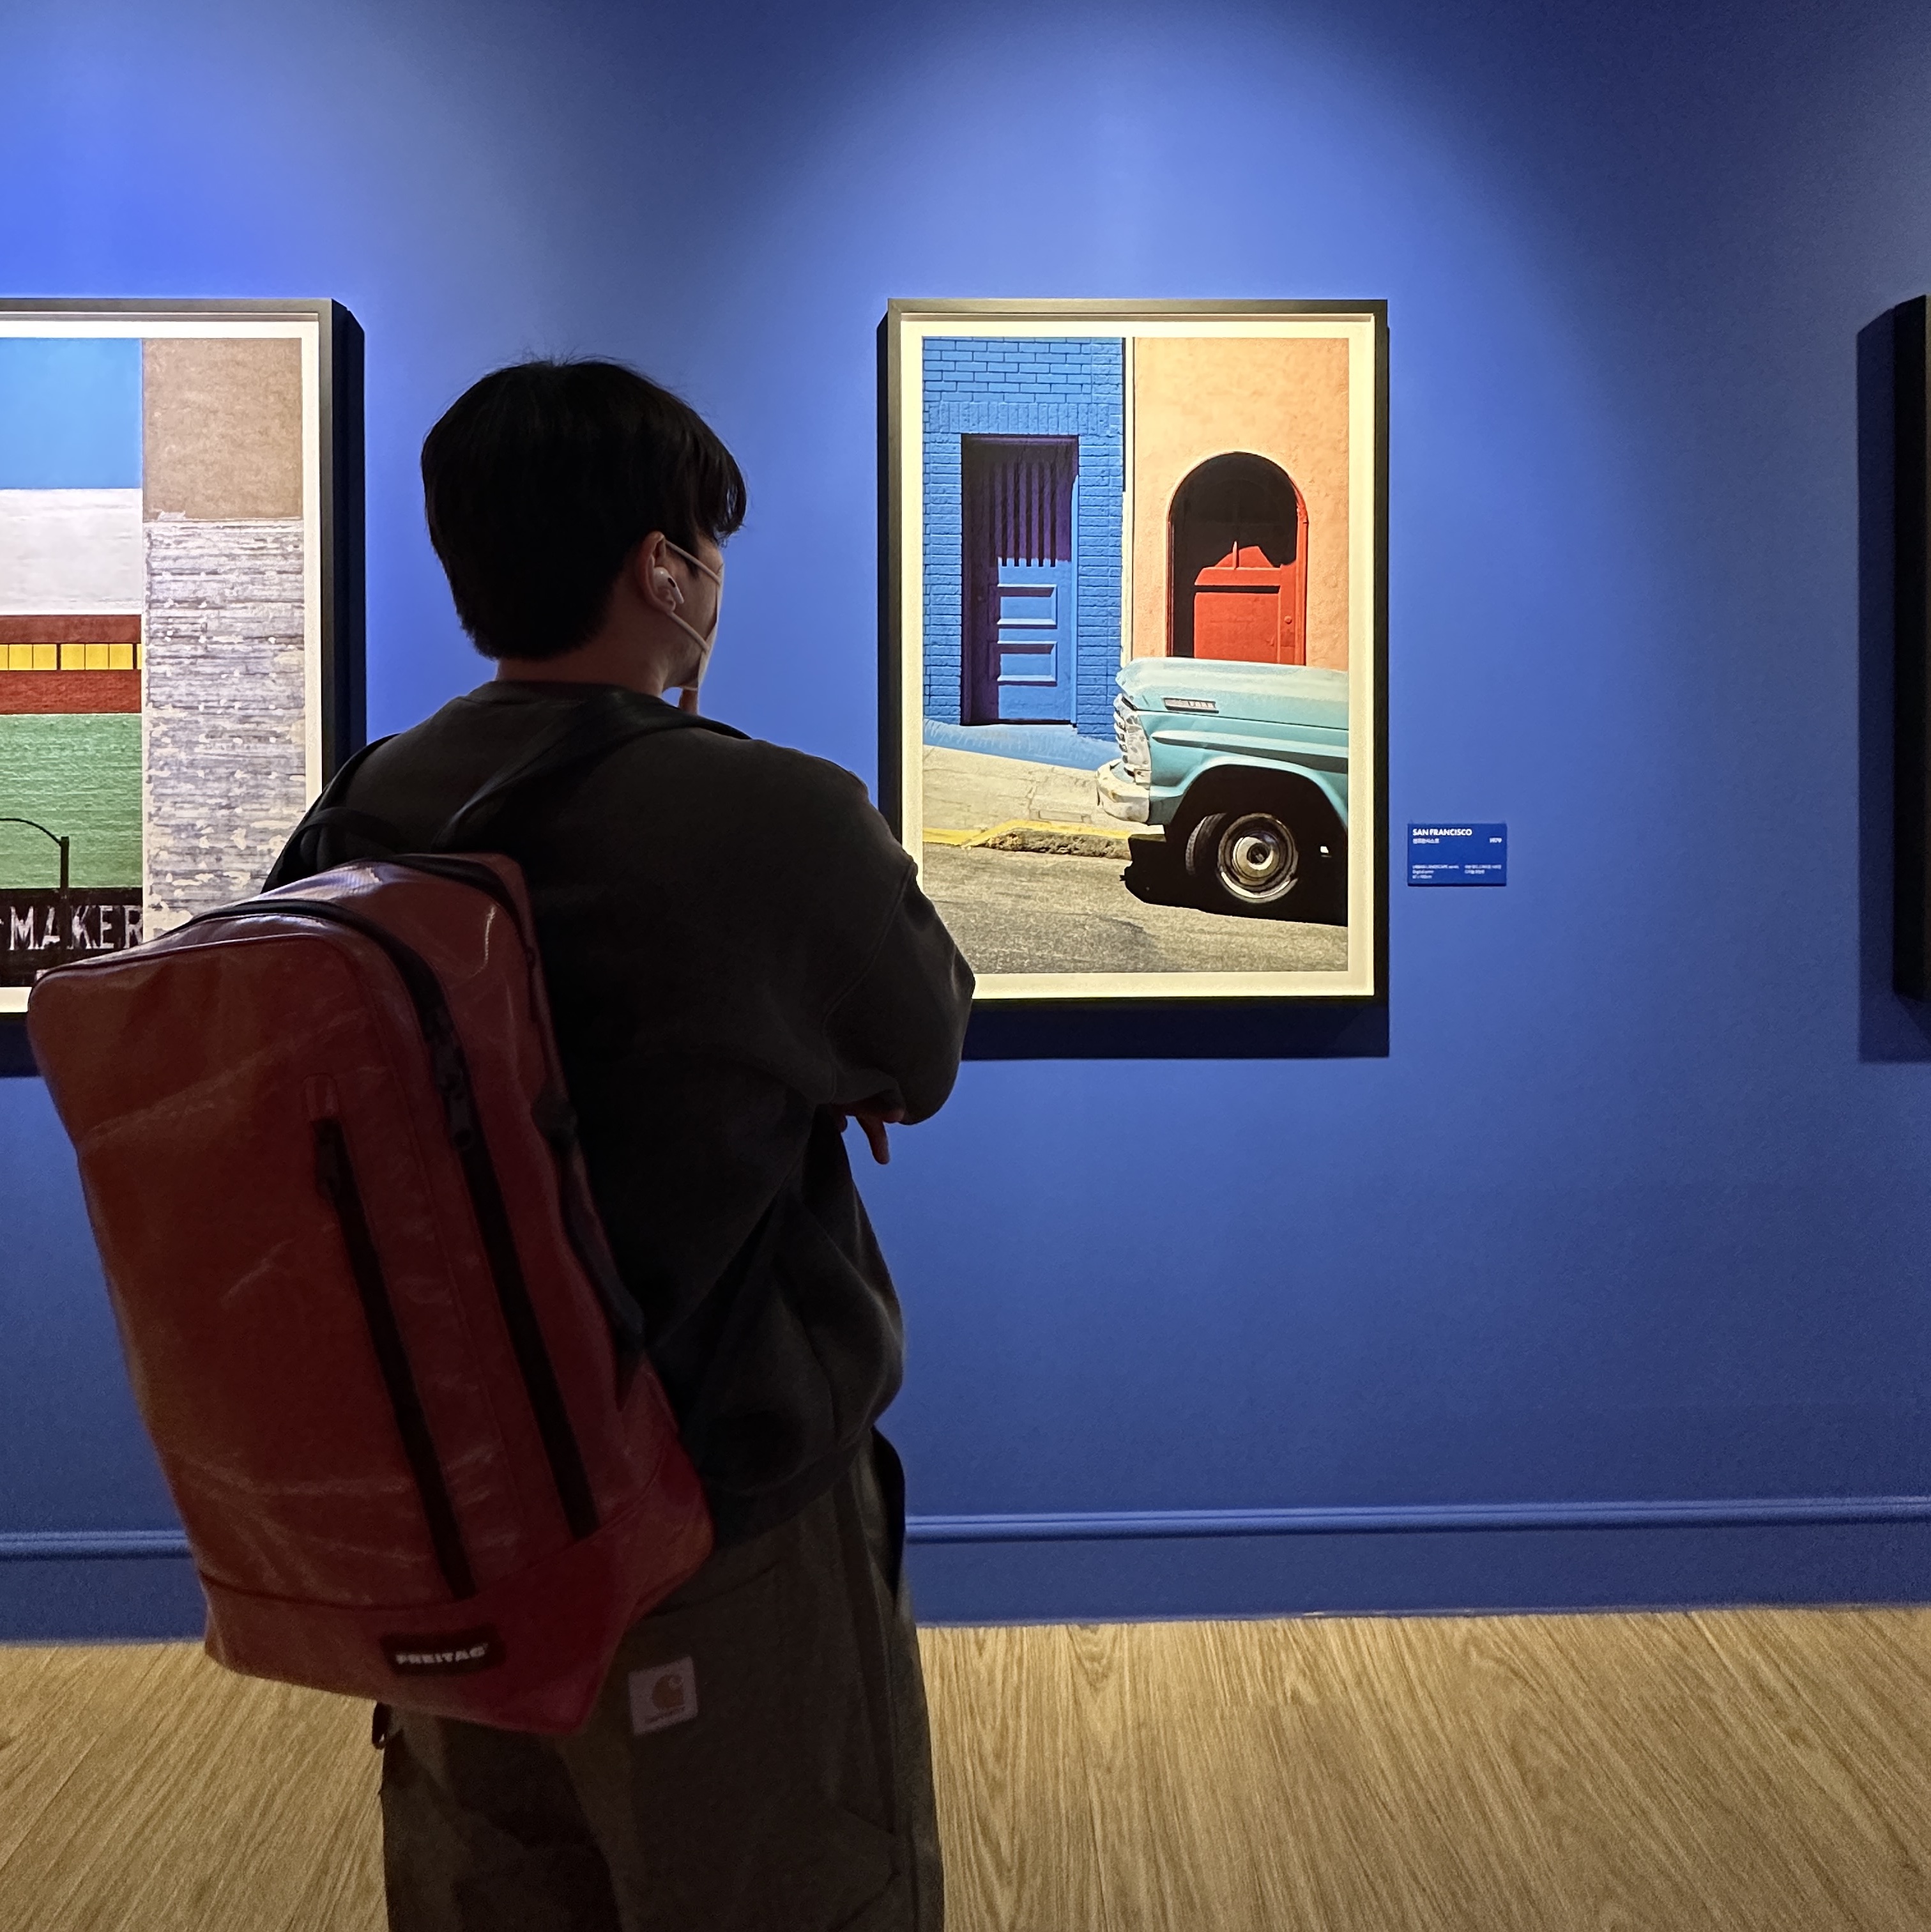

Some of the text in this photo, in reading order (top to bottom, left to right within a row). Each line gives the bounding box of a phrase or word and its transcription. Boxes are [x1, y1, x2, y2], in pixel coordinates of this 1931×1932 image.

[1412, 828, 1473, 836] SAN FRANCISCO
[395, 1644, 487, 1665] FREITAG
